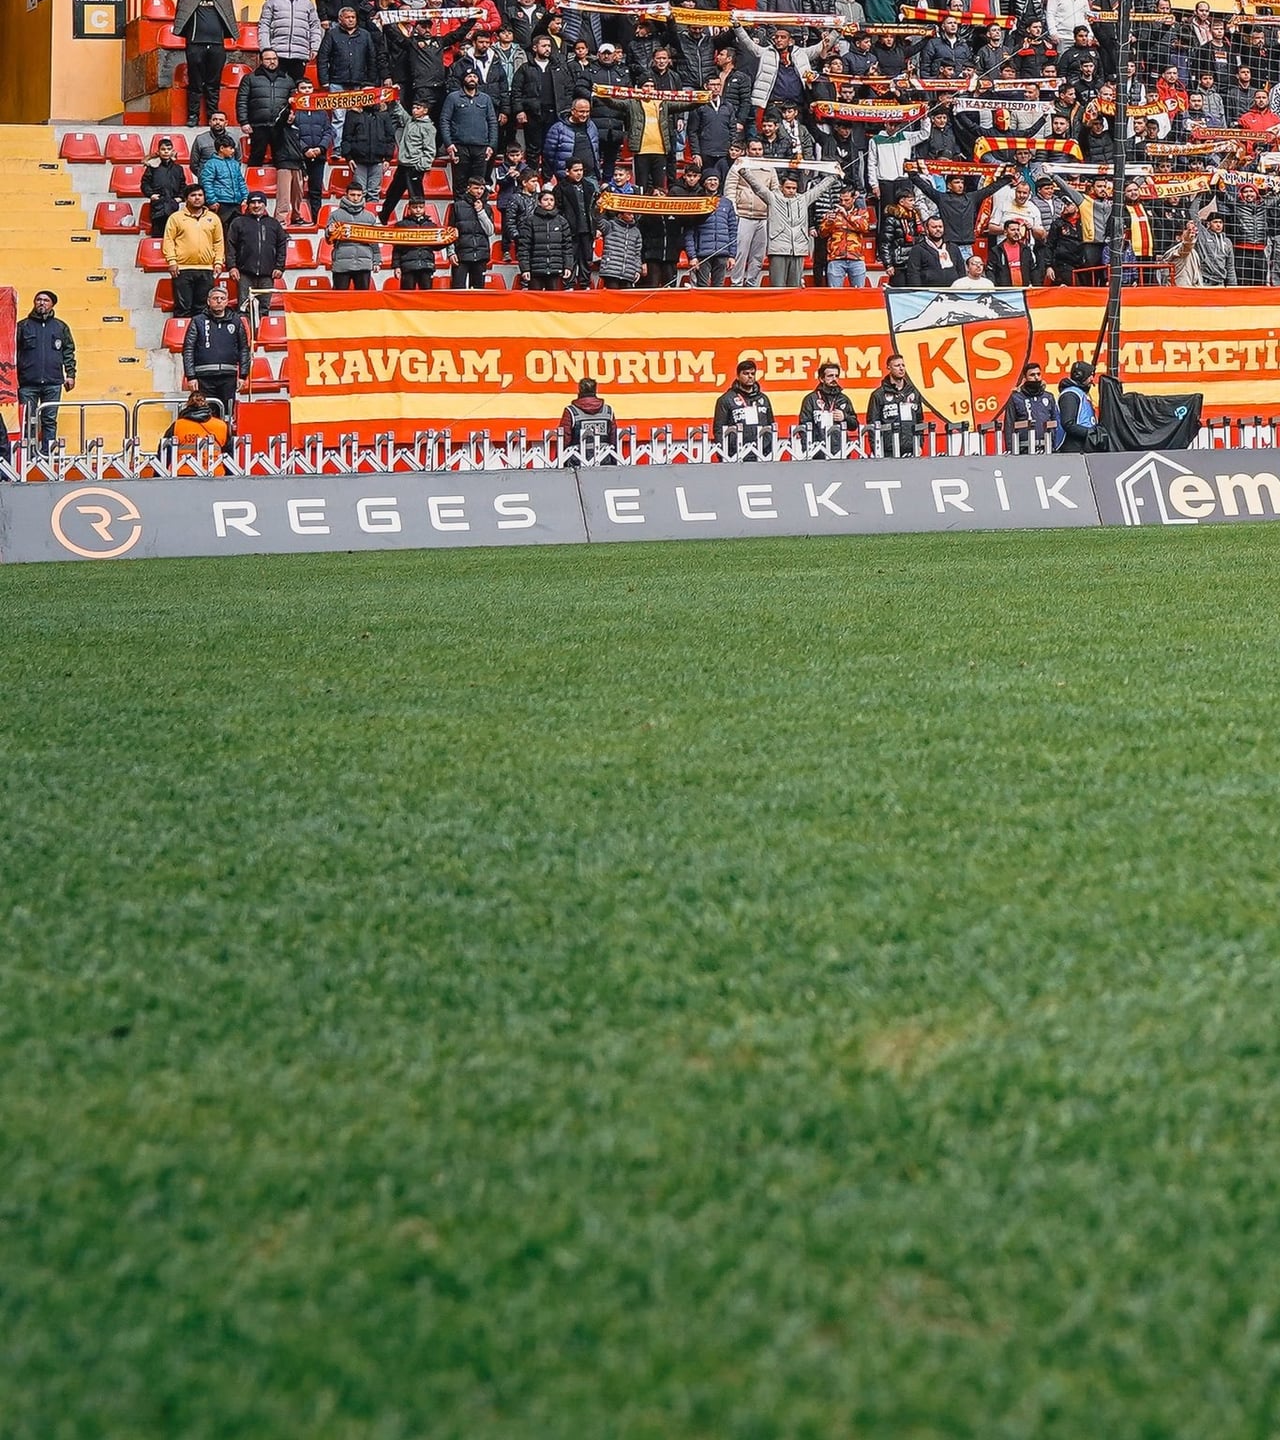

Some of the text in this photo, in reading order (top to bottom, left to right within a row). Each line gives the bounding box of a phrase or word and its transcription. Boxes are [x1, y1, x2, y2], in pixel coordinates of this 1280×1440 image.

[89, 7, 109, 28] C
[868, 27, 934, 37] KAYSERİSPOR
[316, 92, 374, 109] KAYSERİSPOR
[966, 100, 1038, 113] KAYSERİSPOR
[305, 349, 514, 388] KAVGAM,
[525, 349, 726, 387] ONURUM,
[918, 328, 1013, 389] KS
[948, 396, 999, 416] 1966
[212, 469, 1078, 538] REGES ELEKTRİK
